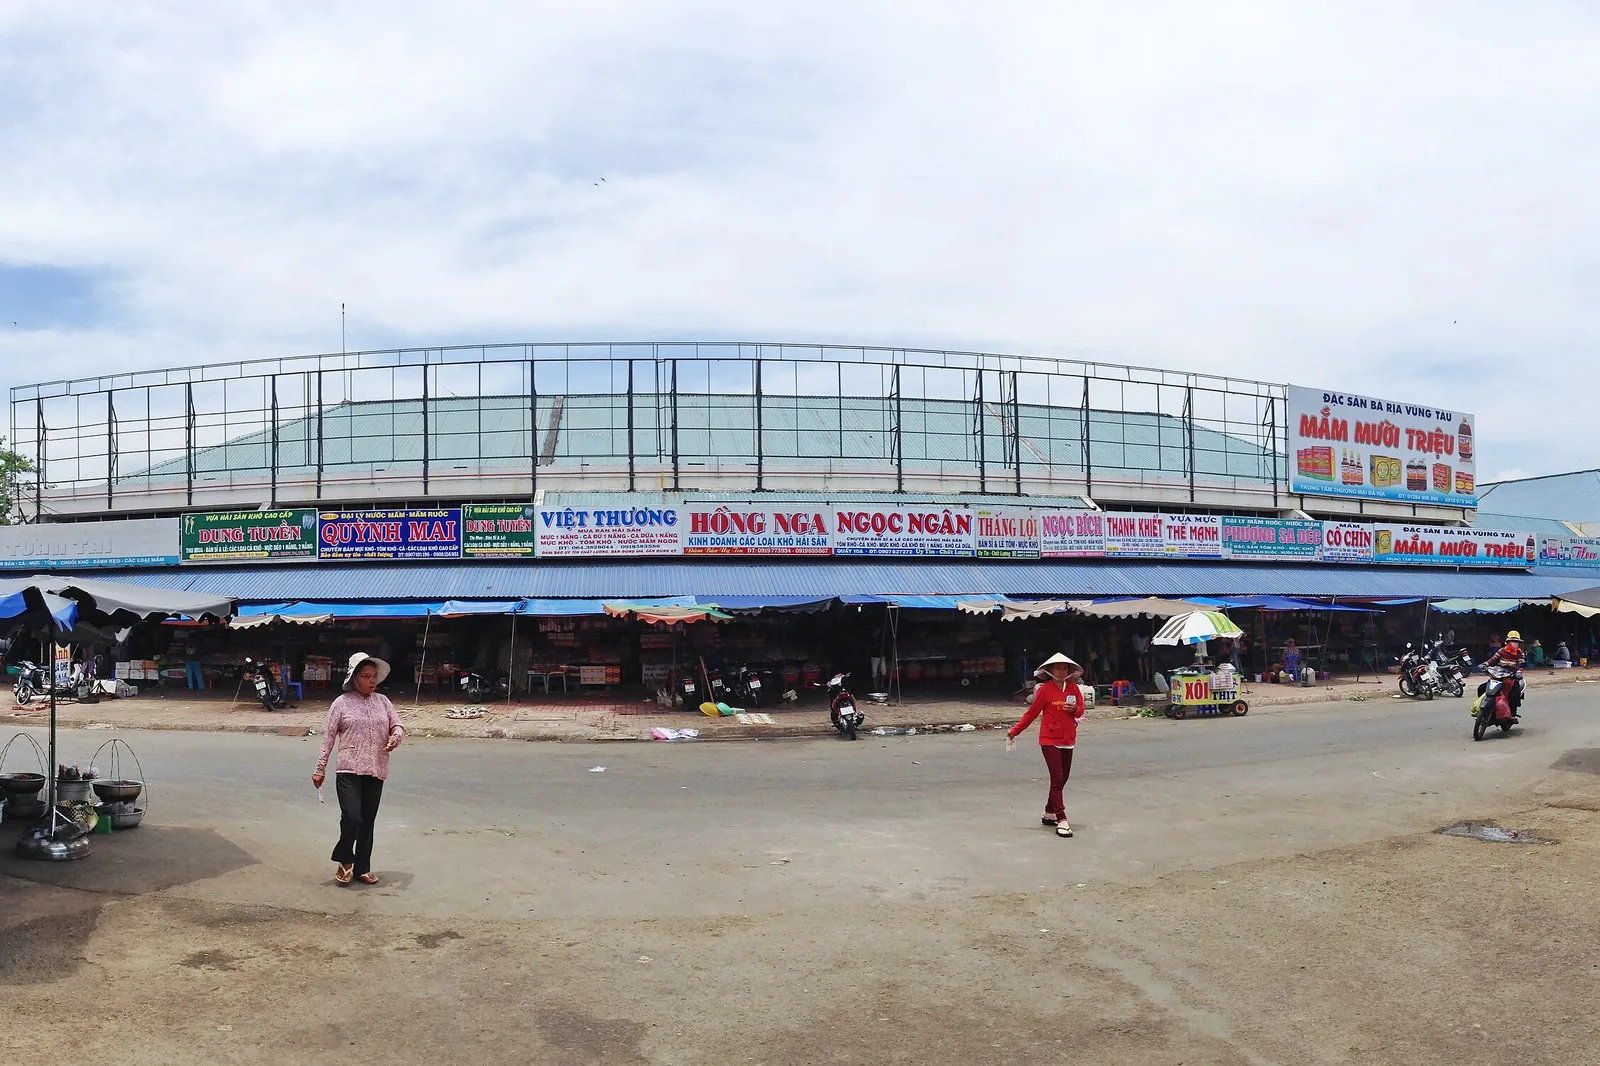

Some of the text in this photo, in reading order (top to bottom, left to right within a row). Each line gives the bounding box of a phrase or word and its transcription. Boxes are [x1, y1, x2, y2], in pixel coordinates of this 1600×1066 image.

[1354, 419, 1400, 448] MƯỜI
[1406, 426, 1454, 459] TRIỆU
[541, 506, 678, 530] VIỆT THƯƠNG
[690, 506, 829, 535] HỒNG NGA
[837, 509, 972, 536] NGỌC NGÂN
[978, 512, 1037, 539] THẮNG LỢI
[1042, 512, 1103, 539] NGỌC BÍCH
[1107, 517, 1136, 536] THANH
[322, 519, 456, 545] QUỲNH MAI
[689, 537, 708, 545] KINH
[711, 537, 737, 545] DOANH
[740, 536, 755, 545] CÁC
[758, 538, 775, 547] LOẠI
[778, 536, 793, 546] KHÔ
[1190, 526, 1218, 543] MẠNH
[1223, 525, 1276, 544] PHƯỢNG
[1279, 528, 1295, 543] SA
[1327, 526, 1372, 547] CÔ CHÍN
[1484, 541, 1524, 561] TRIỆU
[1185, 679, 1208, 700] XÔI
[1212, 690, 1237, 702] THỊT
